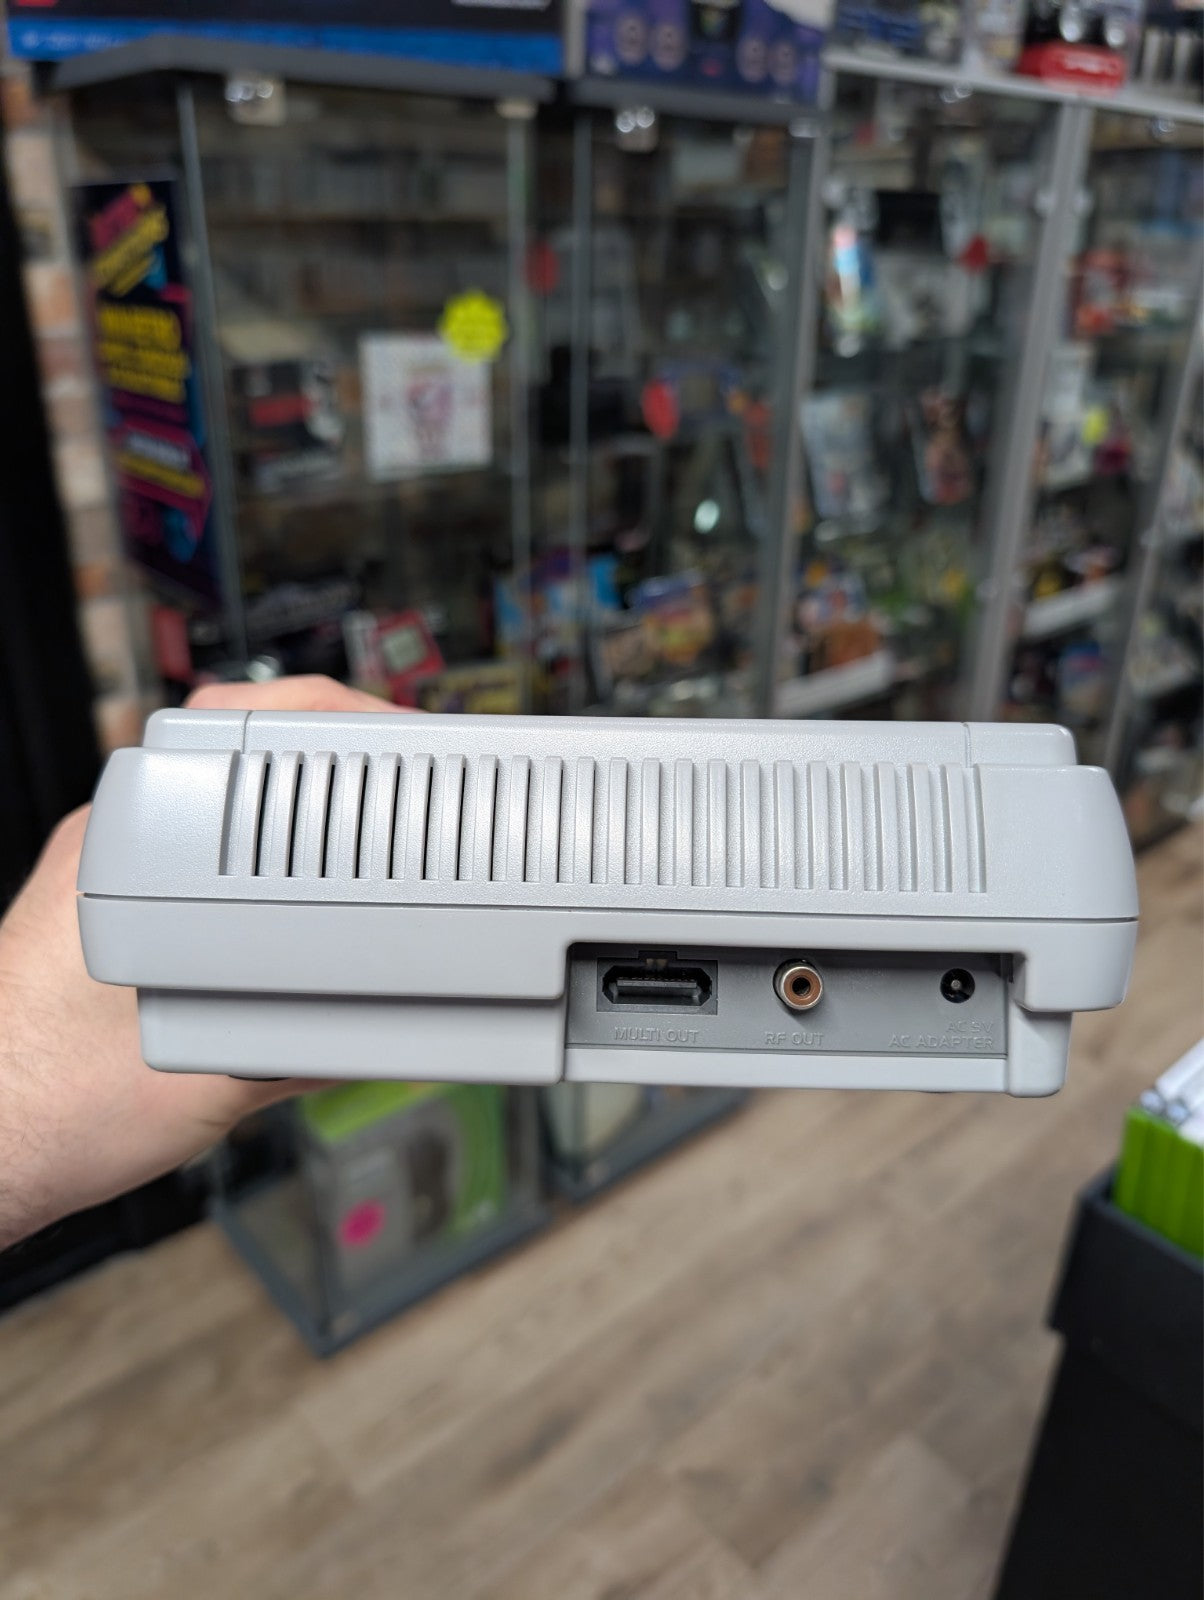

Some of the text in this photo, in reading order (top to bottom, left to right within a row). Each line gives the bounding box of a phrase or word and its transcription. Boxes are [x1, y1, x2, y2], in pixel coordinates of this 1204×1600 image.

[945, 1020, 968, 1033] AC
[614, 1026, 700, 1044] MULTI OUT
[764, 1031, 825, 1046] RF OUT
[888, 1033, 994, 1050] AC ADAPTER
